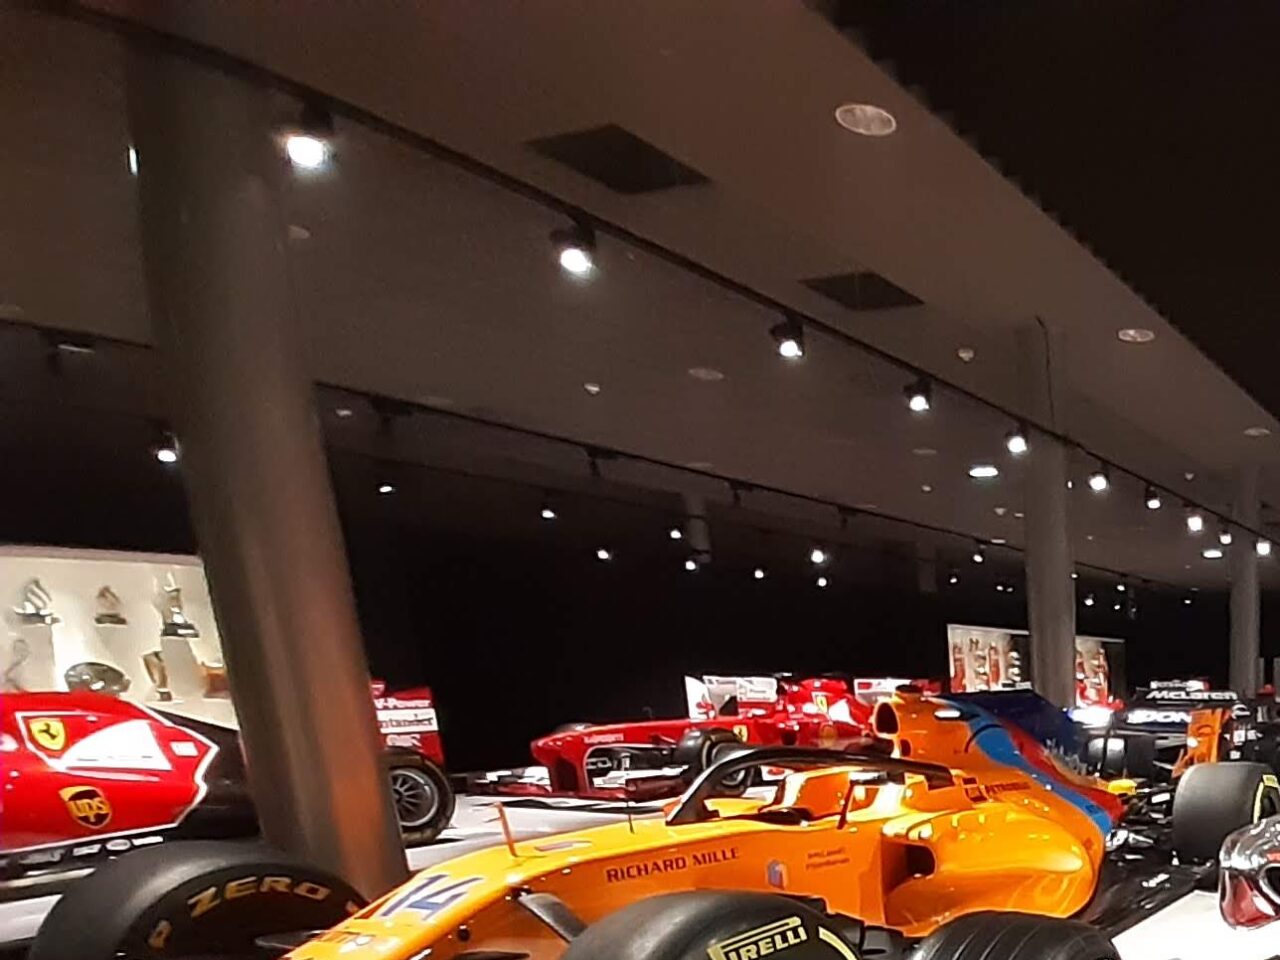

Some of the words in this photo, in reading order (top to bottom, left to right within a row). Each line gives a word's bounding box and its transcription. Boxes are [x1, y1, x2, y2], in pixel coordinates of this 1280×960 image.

[1147, 690, 1238, 700] McLaren
[605, 856, 687, 883] RICHARD
[692, 847, 739, 867] MILLE
[187, 876, 331, 917] ZERO
[381, 874, 483, 921] 14
